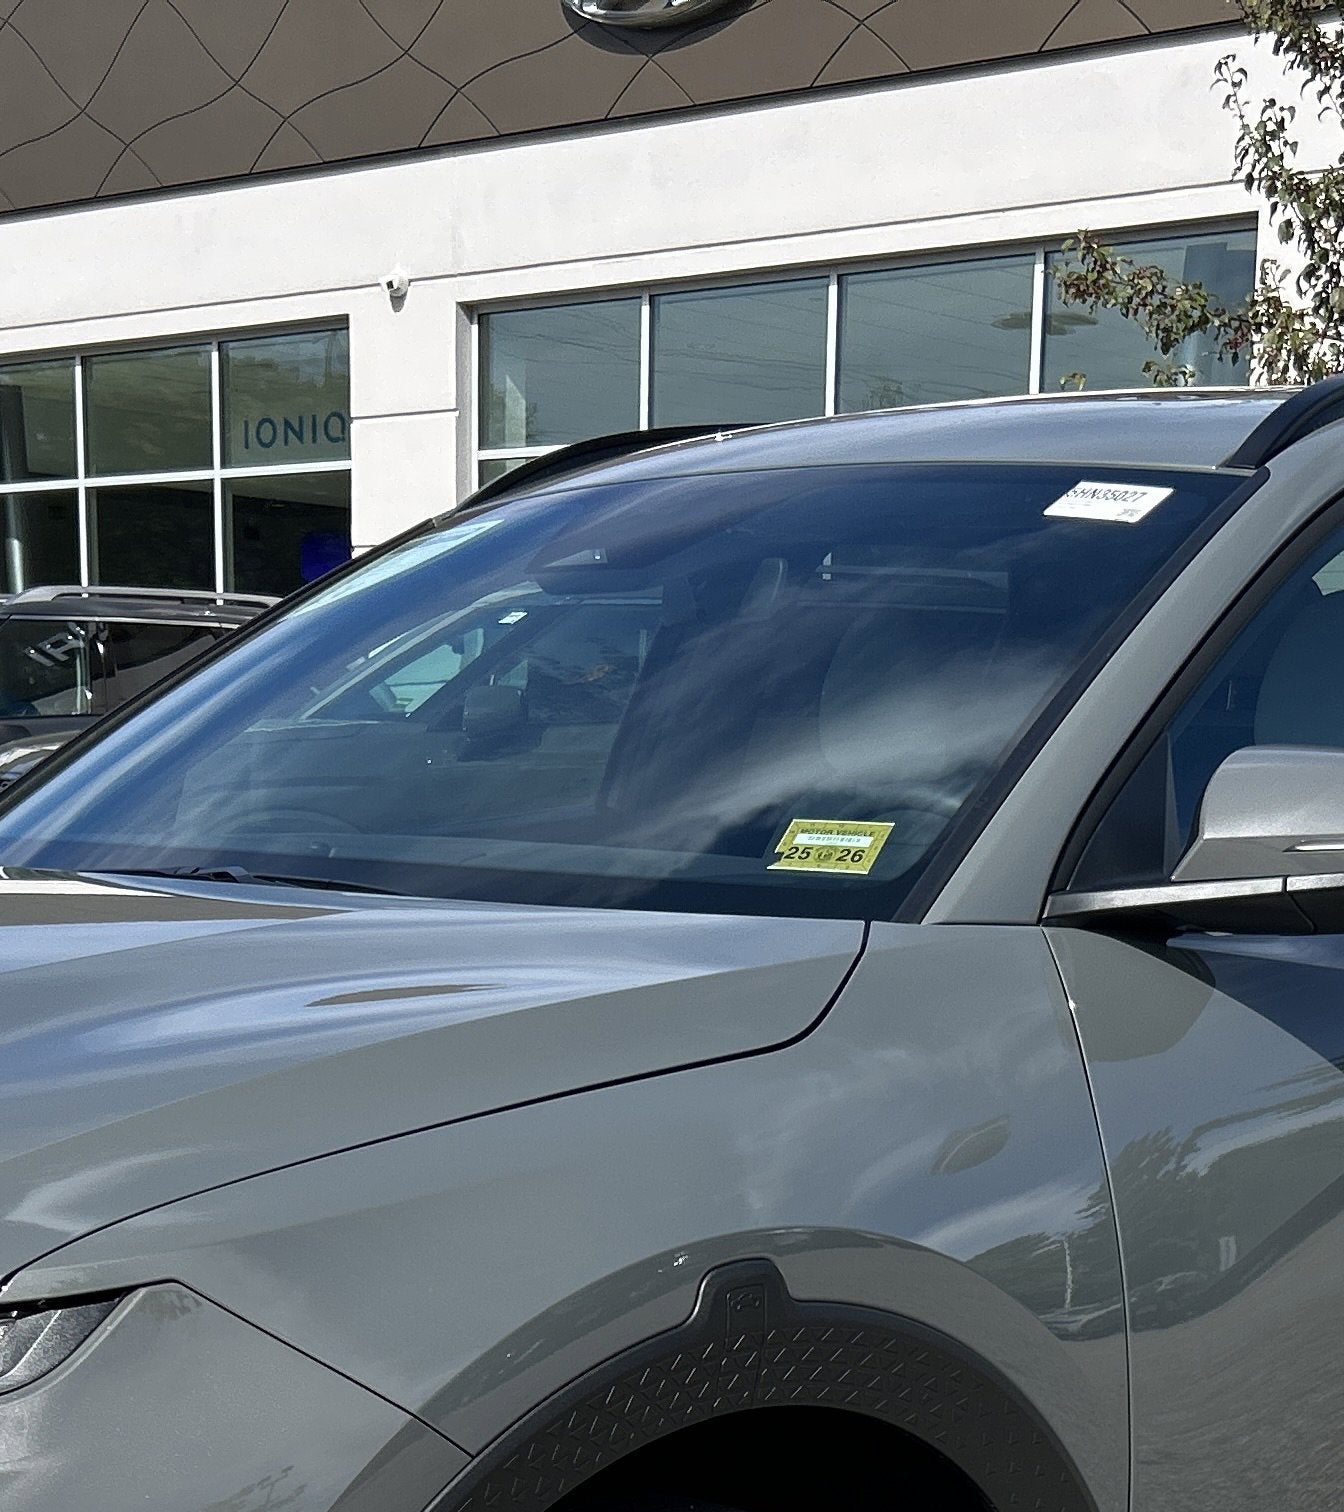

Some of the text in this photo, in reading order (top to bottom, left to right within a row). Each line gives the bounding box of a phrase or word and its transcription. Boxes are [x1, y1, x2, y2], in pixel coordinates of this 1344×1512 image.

[243, 411, 346, 450] IONIQ
[784, 846, 866, 863] 25 26
